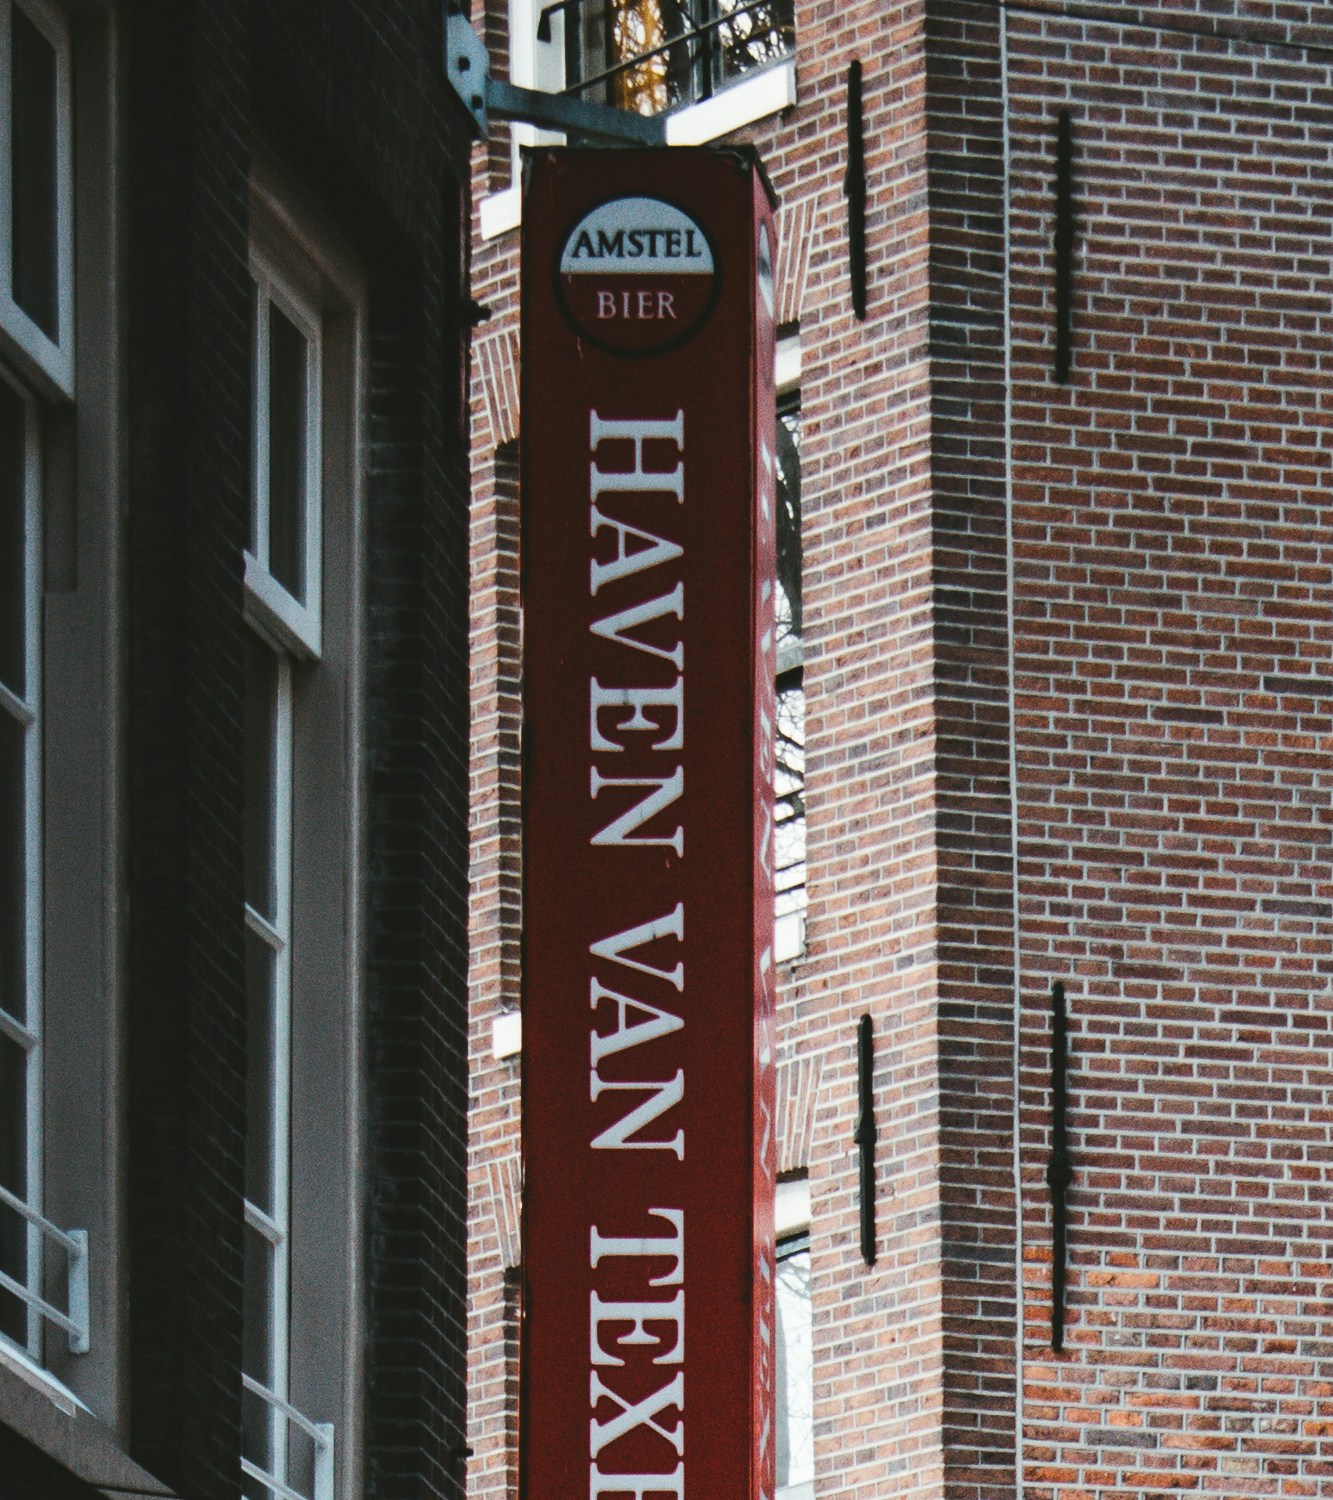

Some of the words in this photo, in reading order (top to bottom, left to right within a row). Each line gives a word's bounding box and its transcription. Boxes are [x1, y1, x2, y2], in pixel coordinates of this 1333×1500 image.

[570, 228, 703, 259] AMSTEL
[596, 290, 678, 320] BIER
[588, 408, 685, 858] HAVEN
[588, 902, 685, 1162] VAN
